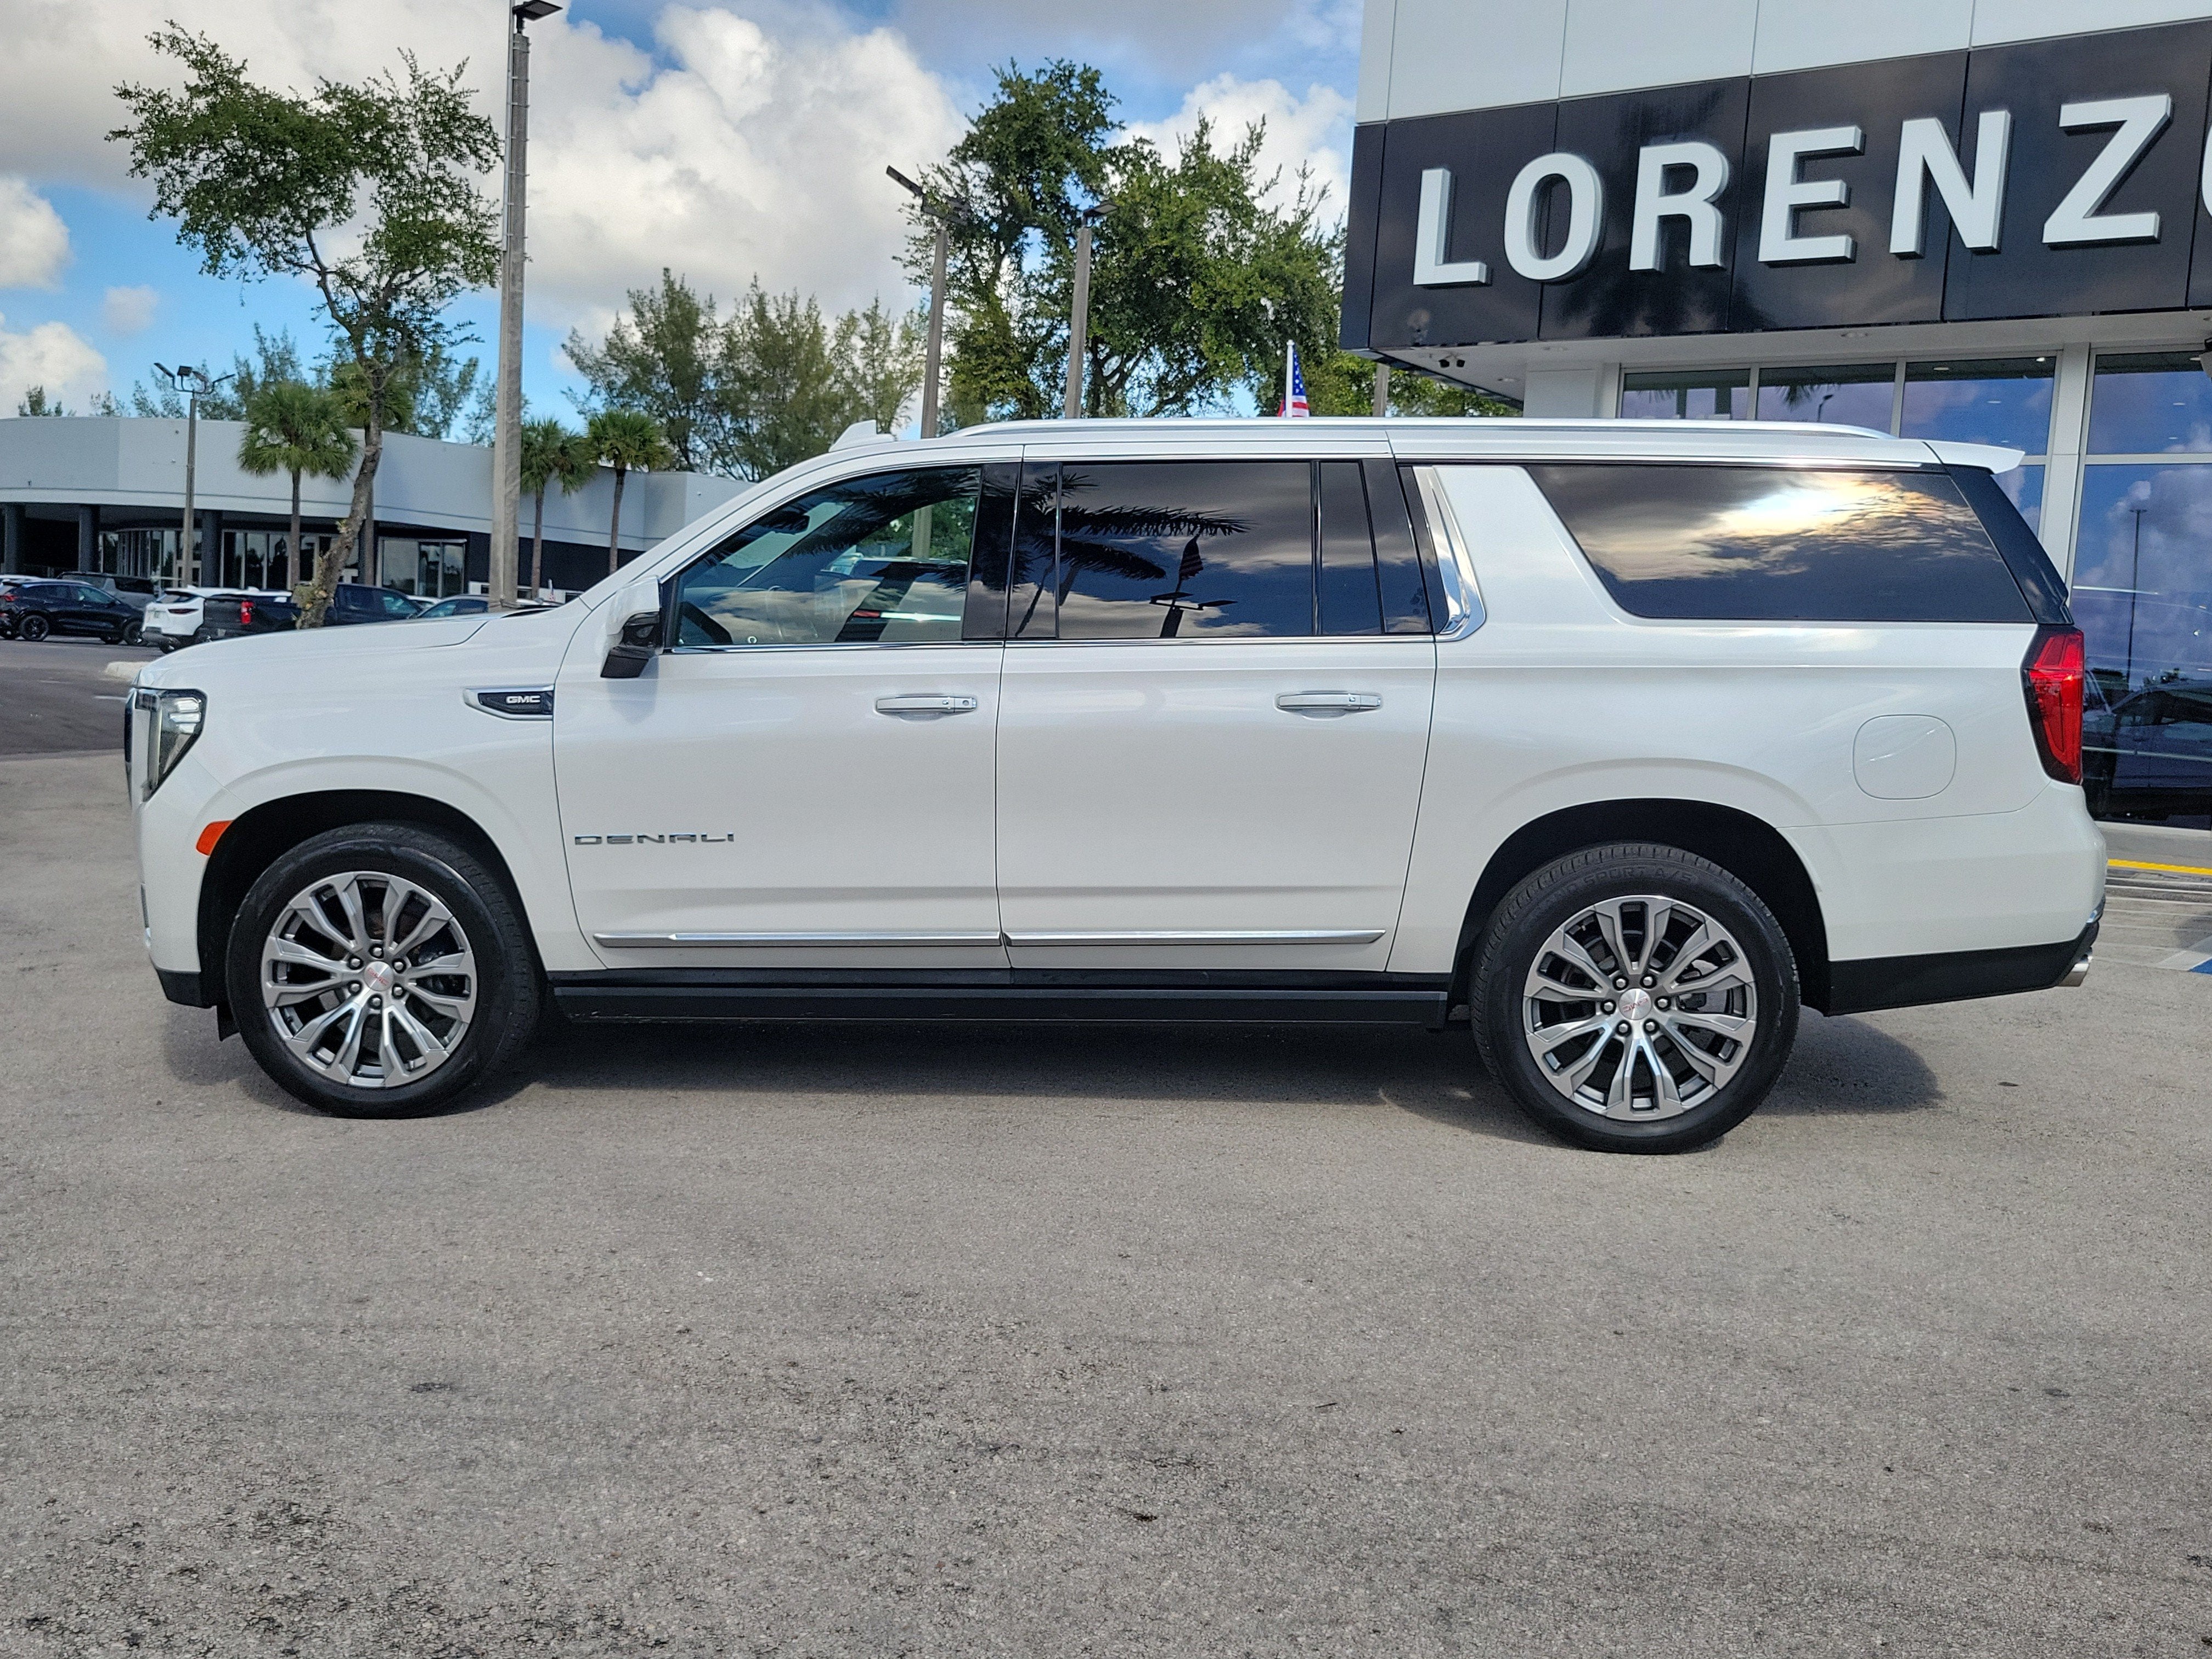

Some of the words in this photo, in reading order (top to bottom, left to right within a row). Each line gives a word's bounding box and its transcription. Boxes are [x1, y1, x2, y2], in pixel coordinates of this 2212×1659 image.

[1412, 93, 2212, 287] LORENZ
[506, 695, 541, 704] GMC
[574, 832, 734, 845] DENALI
